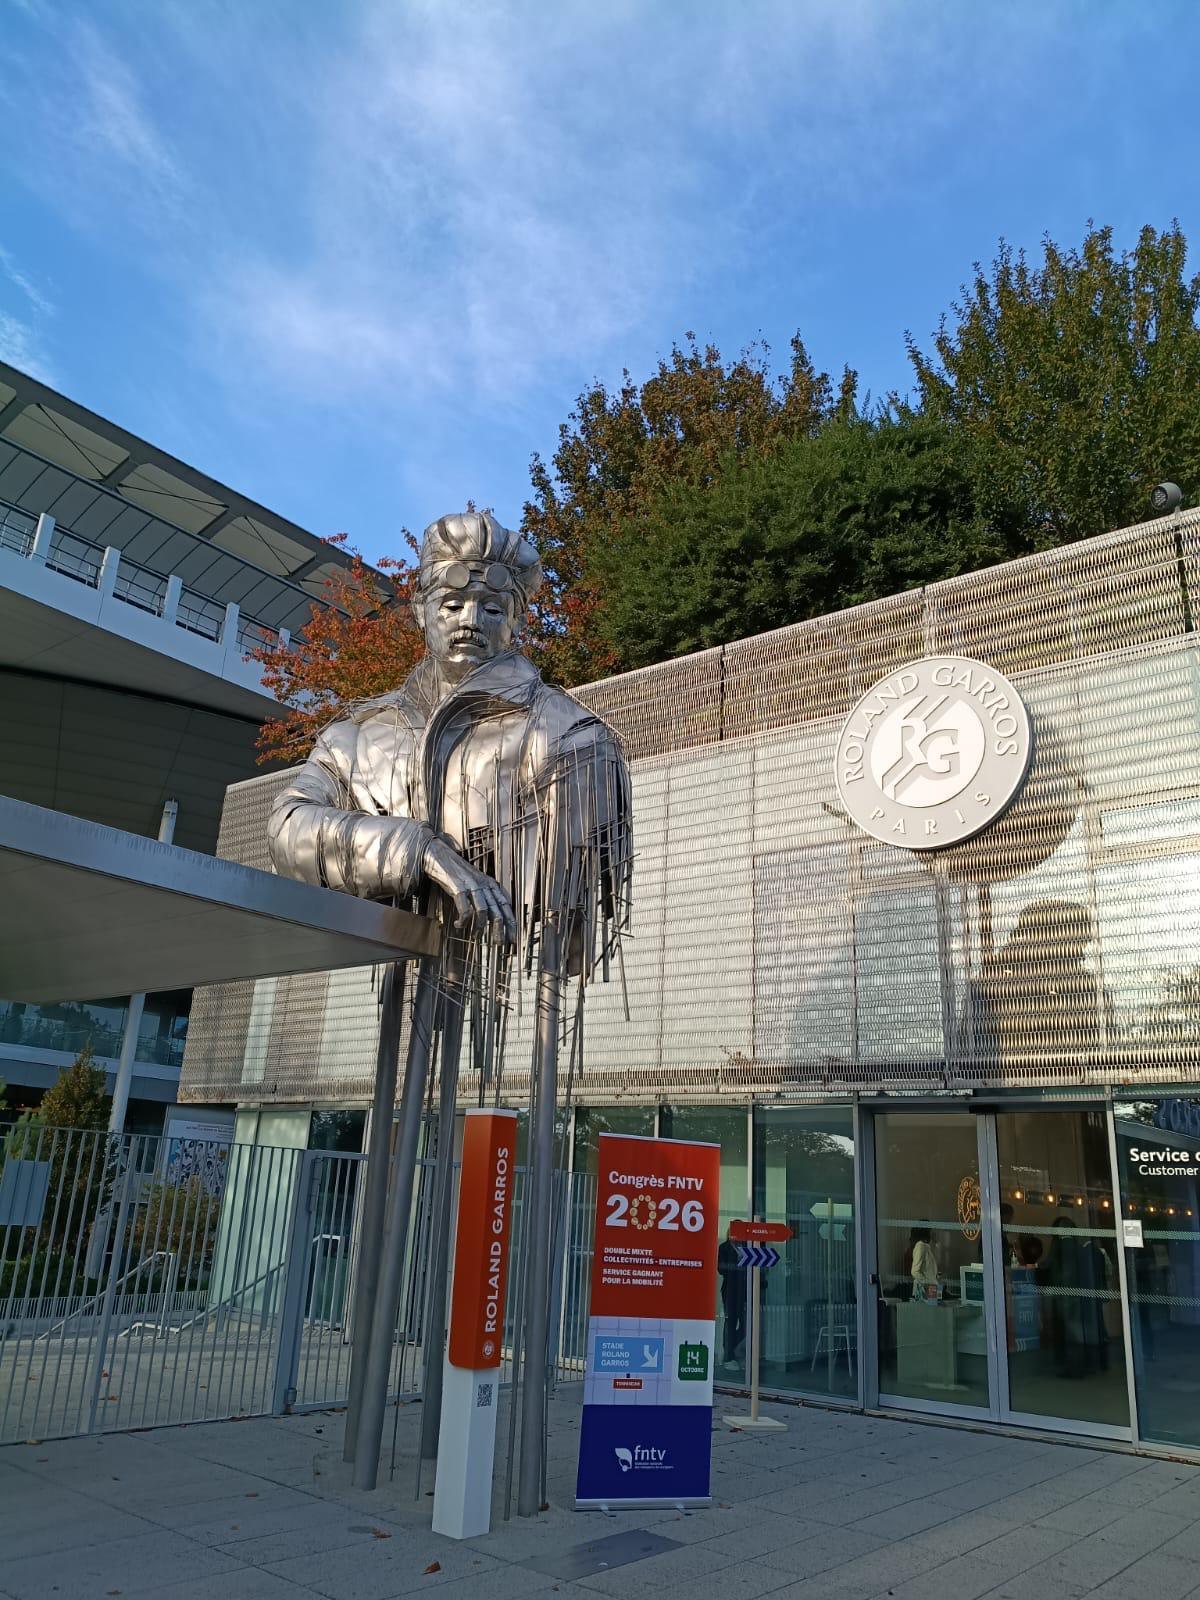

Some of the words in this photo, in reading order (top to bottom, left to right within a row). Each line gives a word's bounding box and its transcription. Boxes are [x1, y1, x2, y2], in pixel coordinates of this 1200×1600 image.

[843, 672, 919, 785] ROLAND
[931, 665, 1018, 757] GARROS
[871, 791, 990, 835] PARIS
[1130, 1147, 1190, 1162] Service
[1138, 1164, 1199, 1176] Customer
[608, 1170, 665, 1189] Congrès
[667, 1175, 704, 1191] FNTV
[492, 1147, 509, 1234] GARROS
[605, 1193, 705, 1232] 2026
[604, 1247, 632, 1255] DOUBLE
[632, 1248, 653, 1256] MIXTE
[603, 1256, 654, 1265] COLLECTIVITÉS
[659, 1259, 703, 1267] ENTREPRISES
[603, 1268, 631, 1276] SERVICE
[485, 1242, 502, 1332] ROLAND
[632, 1278, 664, 1286] MOBILITÉ
[687, 1351, 700, 1365] 14
[634, 1445, 666, 1461] fntv
